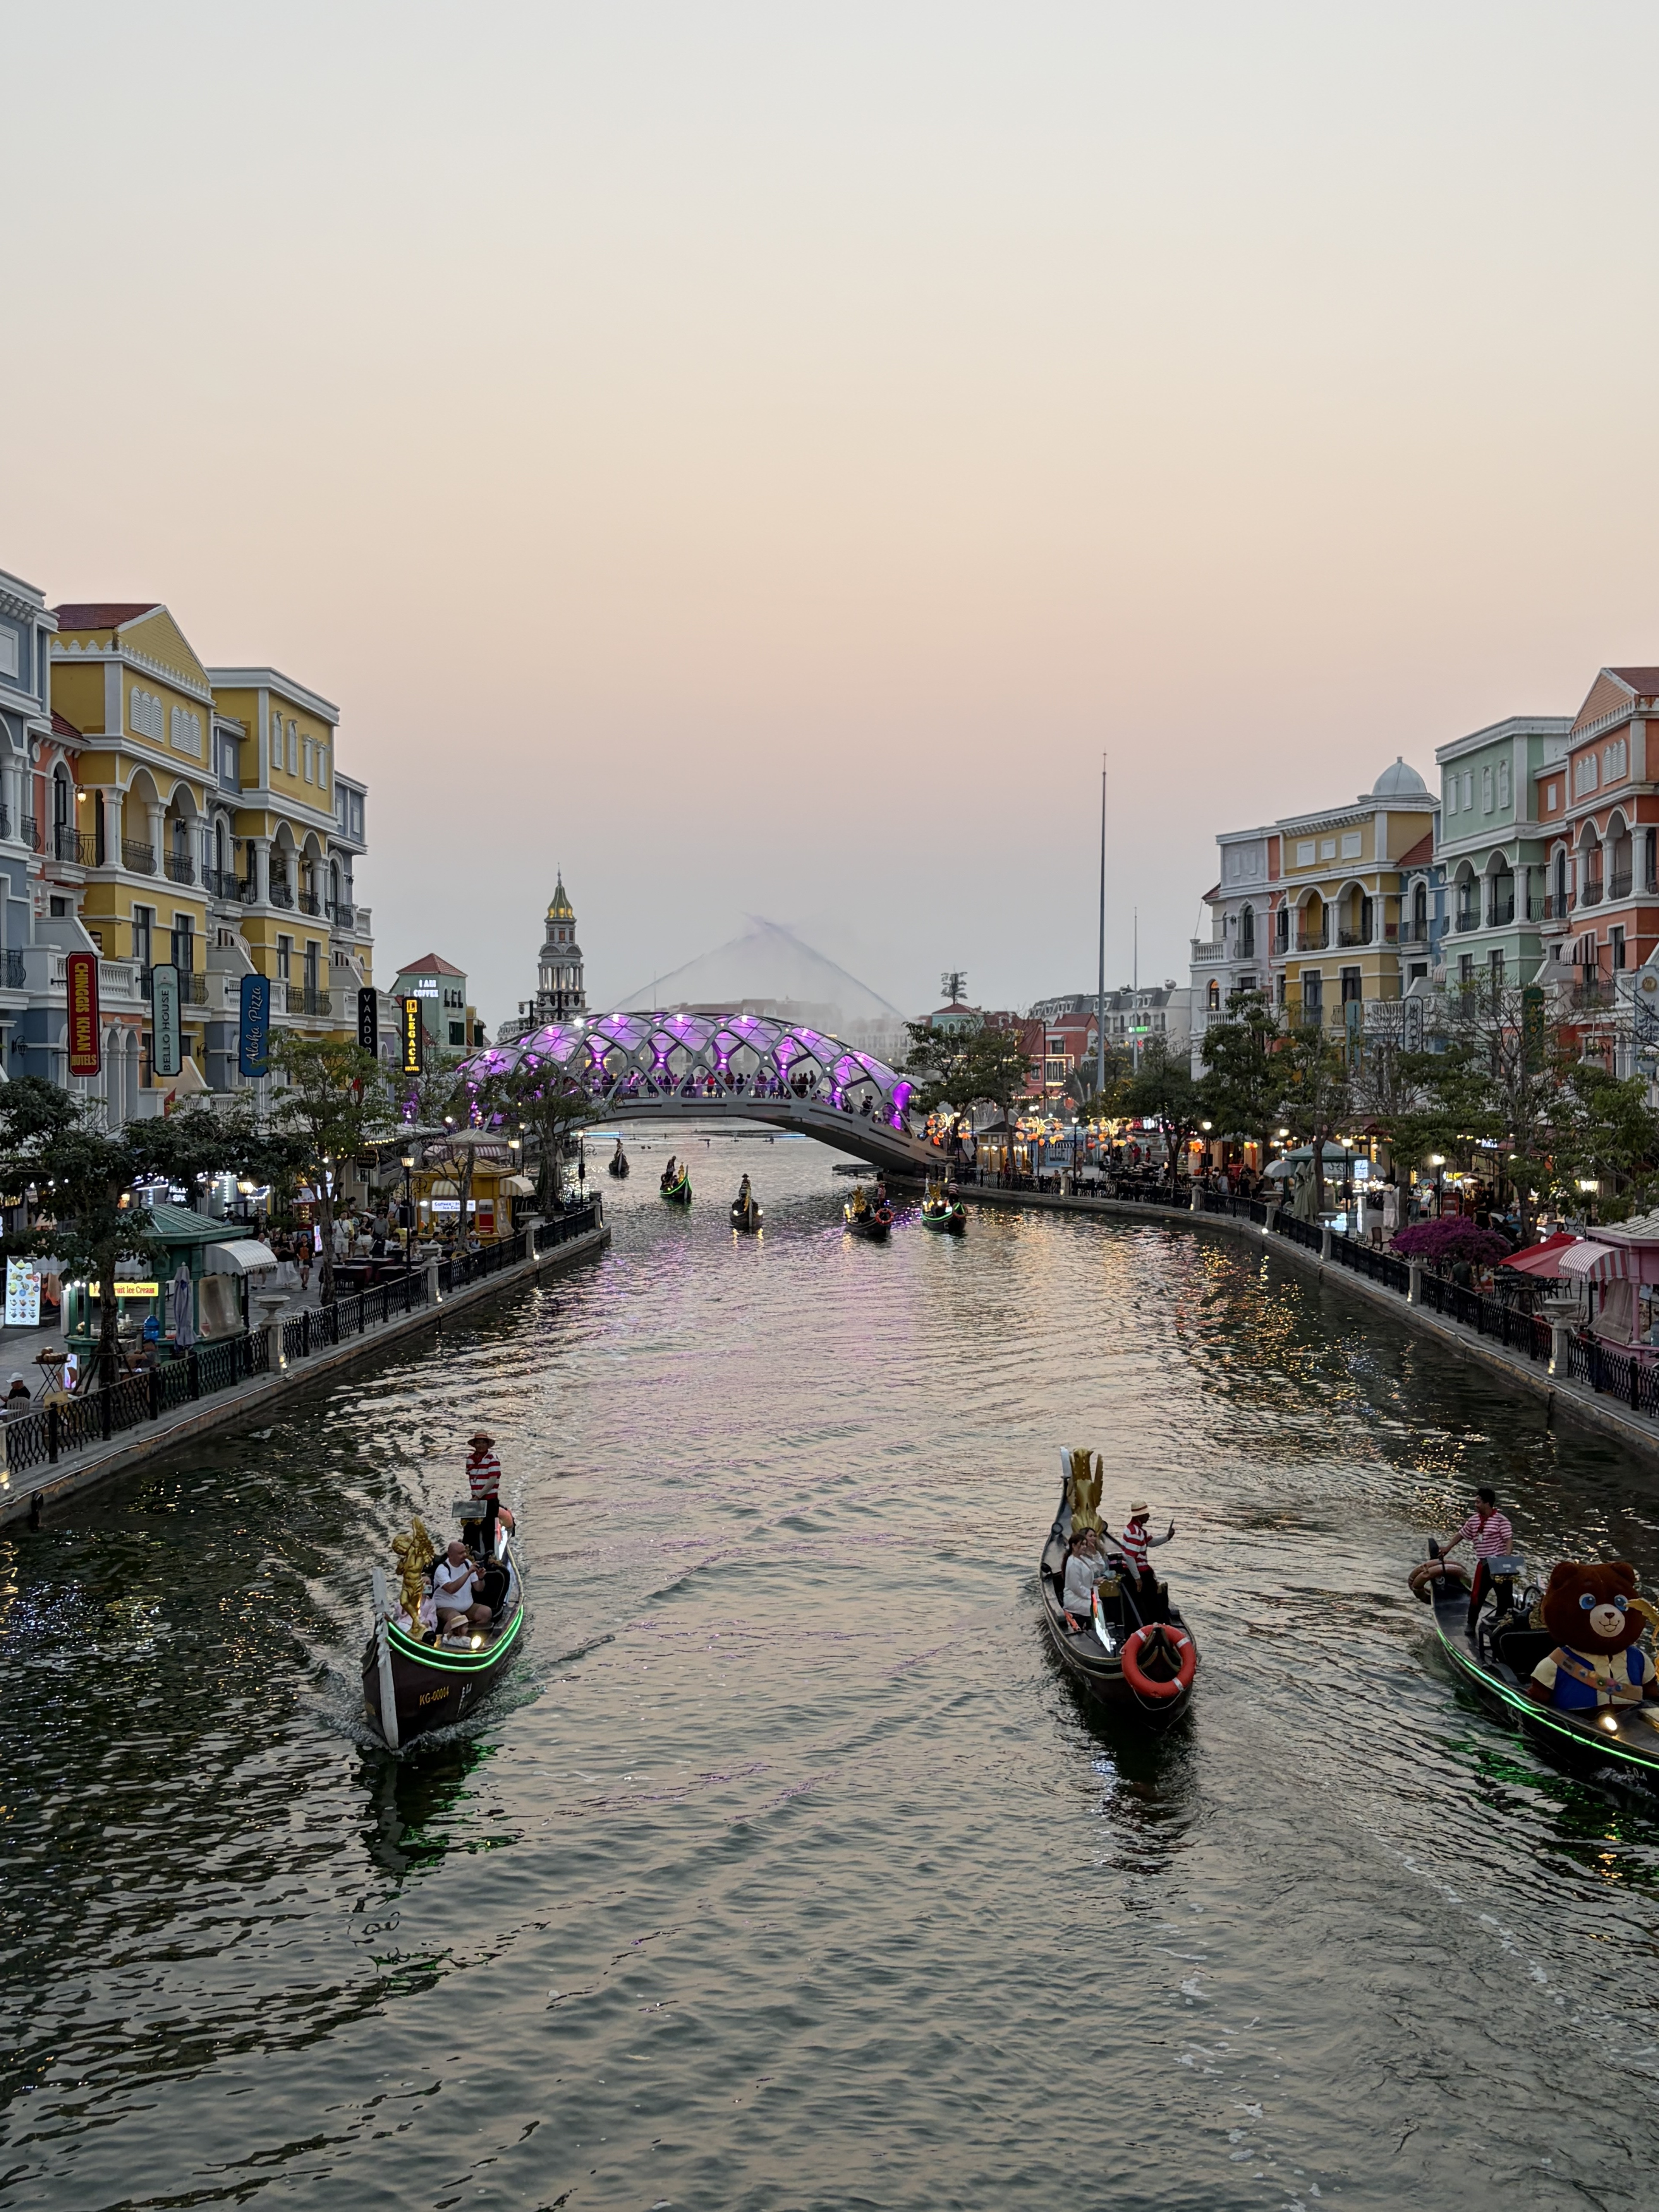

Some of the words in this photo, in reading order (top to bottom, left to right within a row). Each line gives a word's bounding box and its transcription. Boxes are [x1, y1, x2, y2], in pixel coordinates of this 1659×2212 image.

[75, 962, 90, 1013] CHINGGIS
[413, 989, 439, 998] COFFEE
[419, 979, 423, 988] I
[424, 979, 436, 988] AM
[161, 989, 170, 1030] HOUSE
[248, 986, 263, 1022] Pizza
[76, 1017, 91, 1051] KHAN
[245, 1026, 262, 1064] Aloha
[408, 1013, 416, 1065] LEGACY
[71, 1054, 97, 1066] HOTELS
[163, 1034, 171, 1072] BELLO
[126, 1285, 135, 1294] Ice
[136, 1286, 155, 1294] Cream
